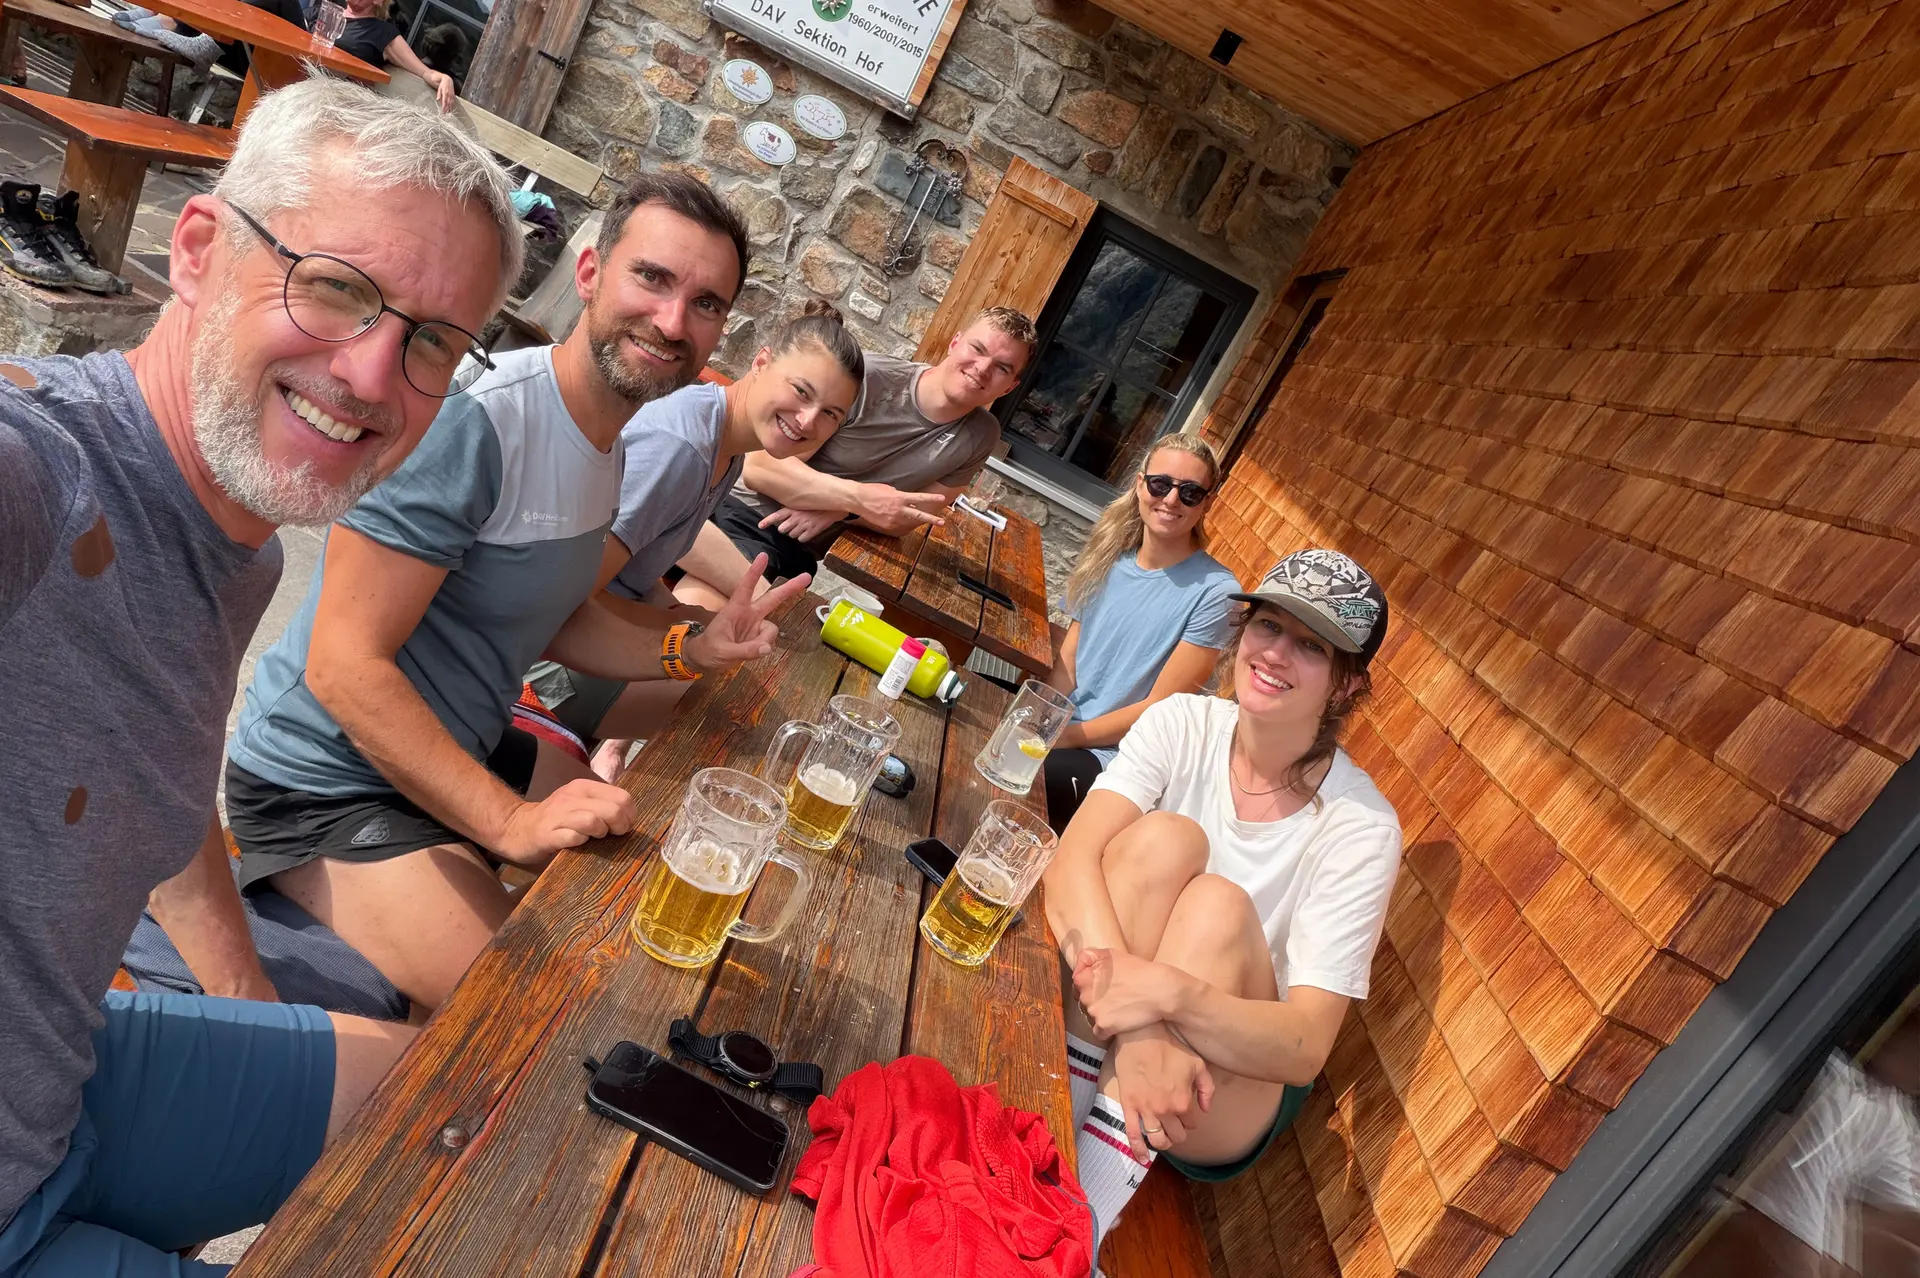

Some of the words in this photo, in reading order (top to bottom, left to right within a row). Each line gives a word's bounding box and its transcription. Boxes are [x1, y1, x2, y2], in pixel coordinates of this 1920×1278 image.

[750, 0, 787, 24] DAV
[793, 19, 848, 58] Sektion
[854, 51, 884, 75] Hof
[848, 12, 925, 59] 1960/2001/2015
[867, 3, 920, 35] erweitert
